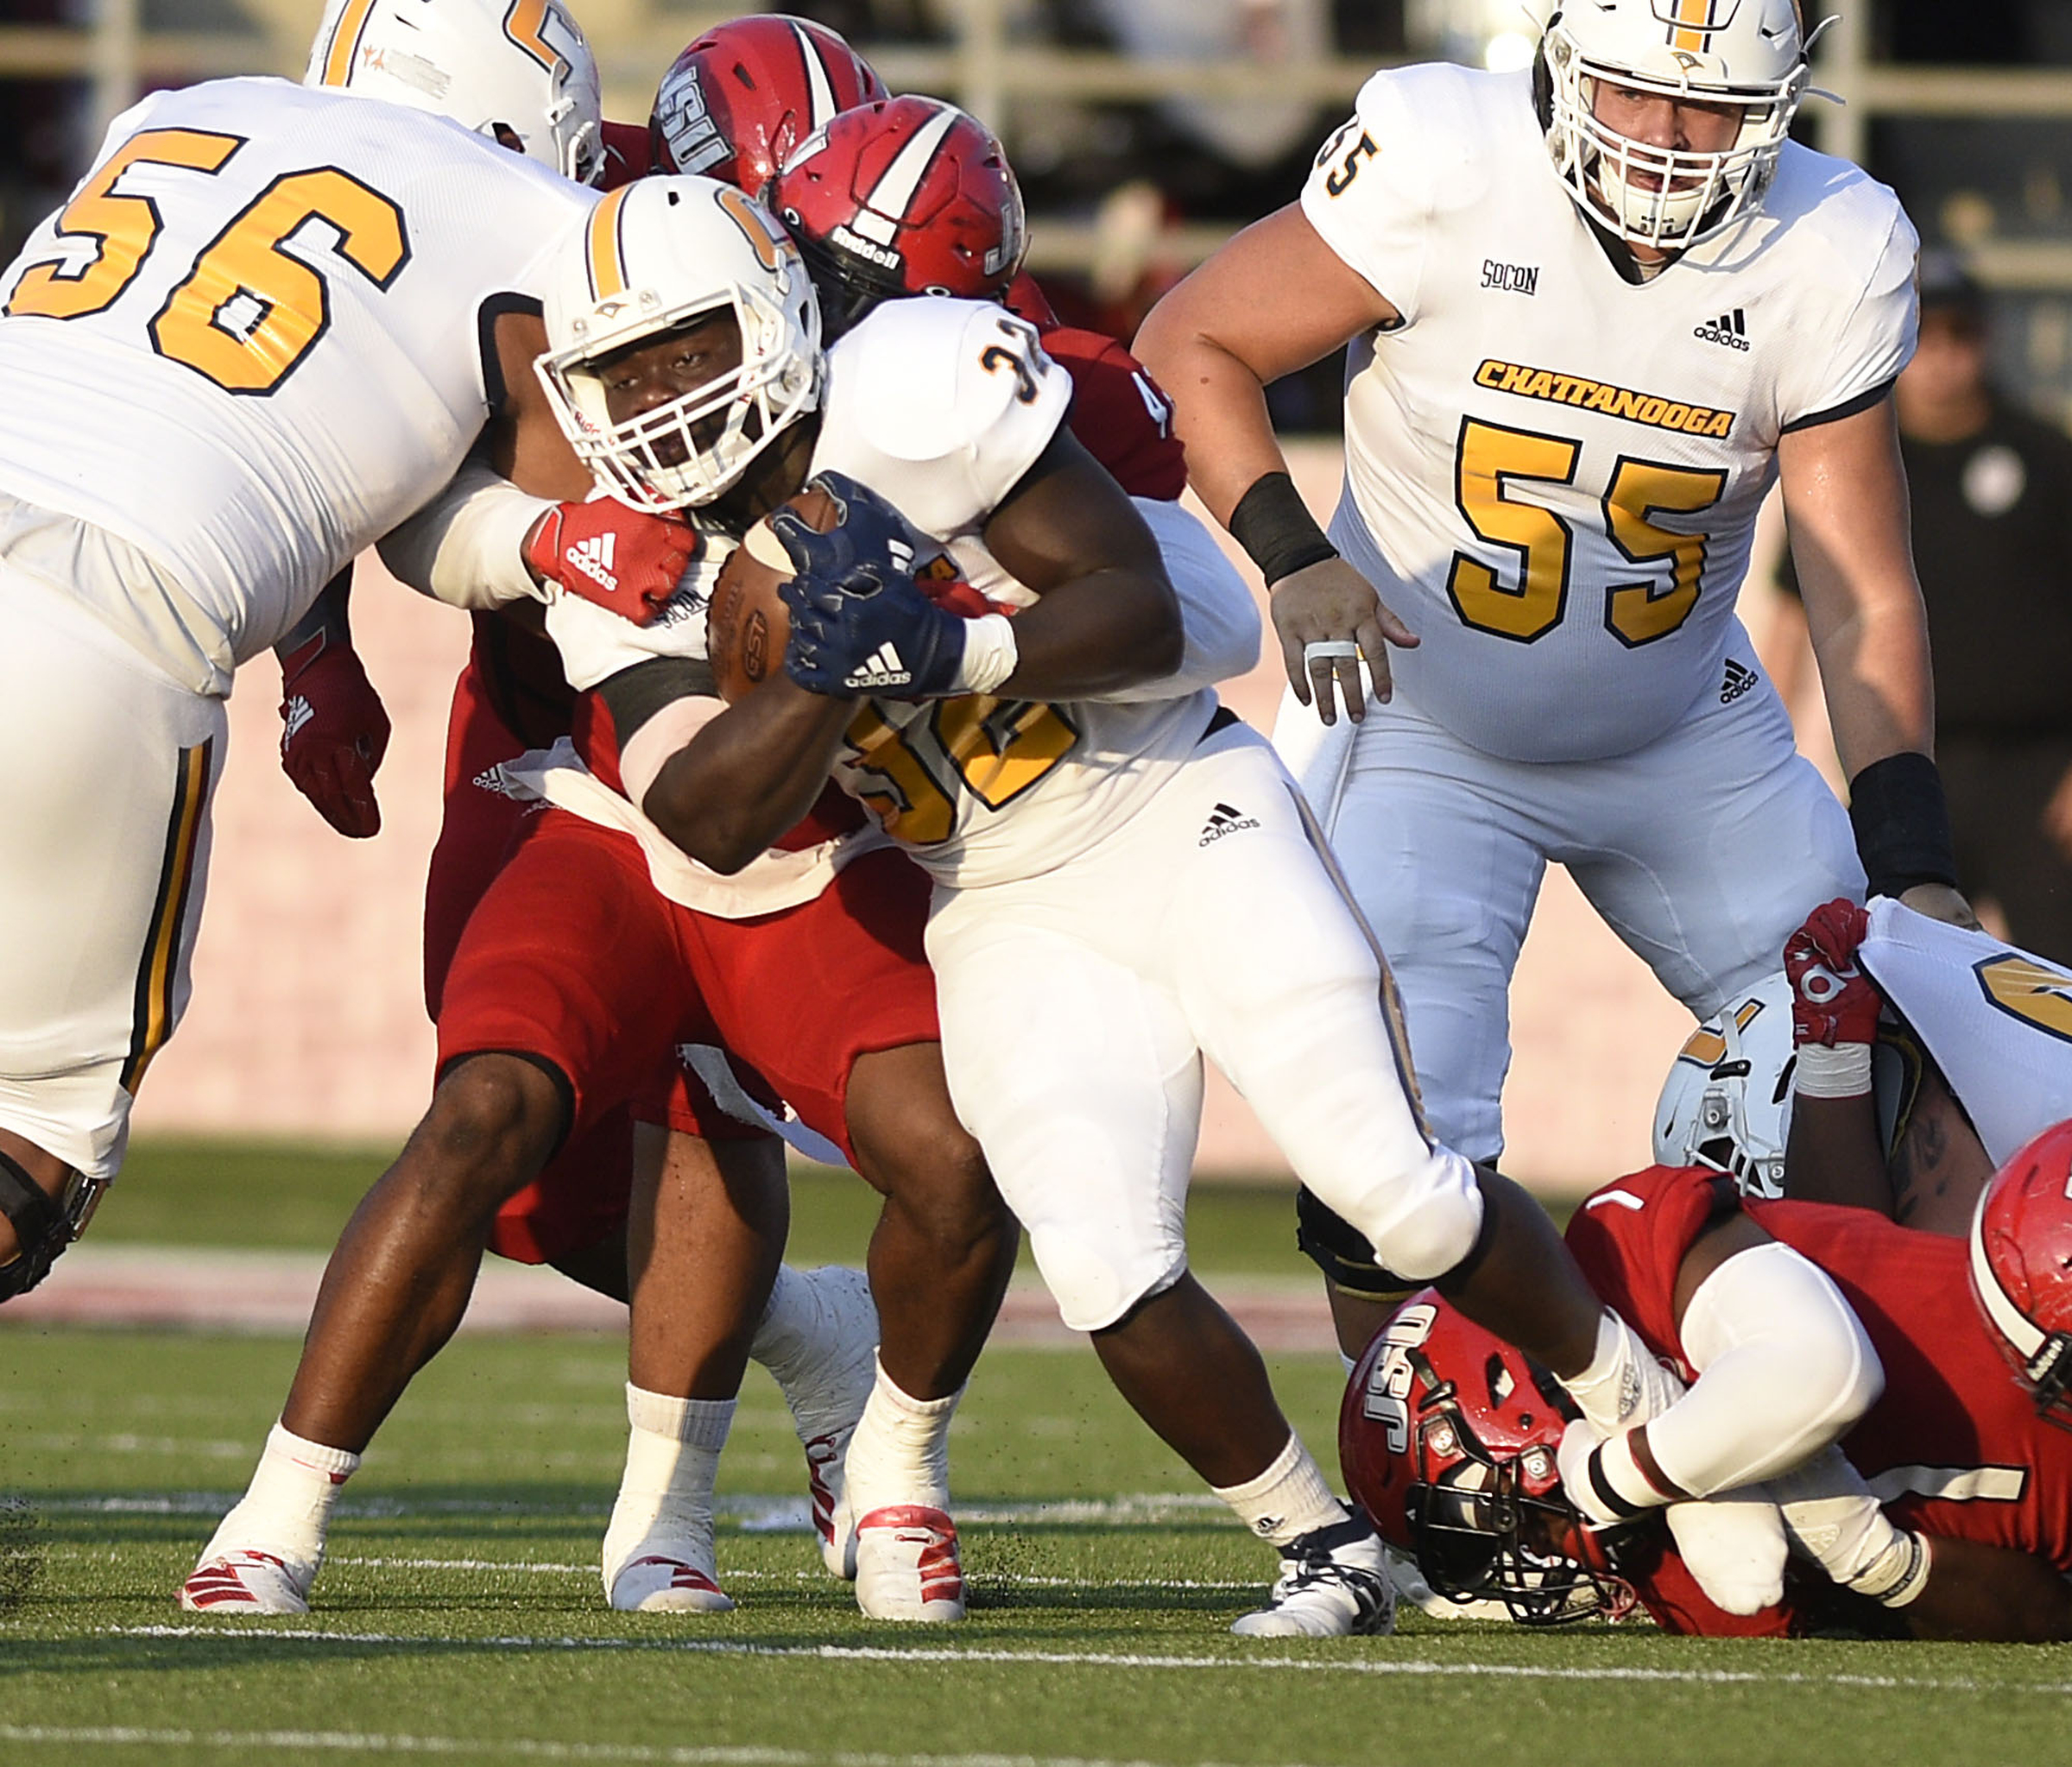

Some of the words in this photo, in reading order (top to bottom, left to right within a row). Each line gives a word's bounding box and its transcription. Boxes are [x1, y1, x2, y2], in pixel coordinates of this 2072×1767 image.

[2, 127, 412, 397] 56
[831, 224, 900, 270] Riddell
[1693, 325, 1750, 351] adidas
[1475, 359, 1736, 439] CHATTANOOGA
[1446, 414, 1729, 649] 55
[566, 547, 618, 591] adidas
[844, 671, 912, 688] adidas
[1720, 670, 1759, 704] adidas
[1198, 818, 1260, 847] adidas
[1364, 1304, 1437, 1454] JSU
